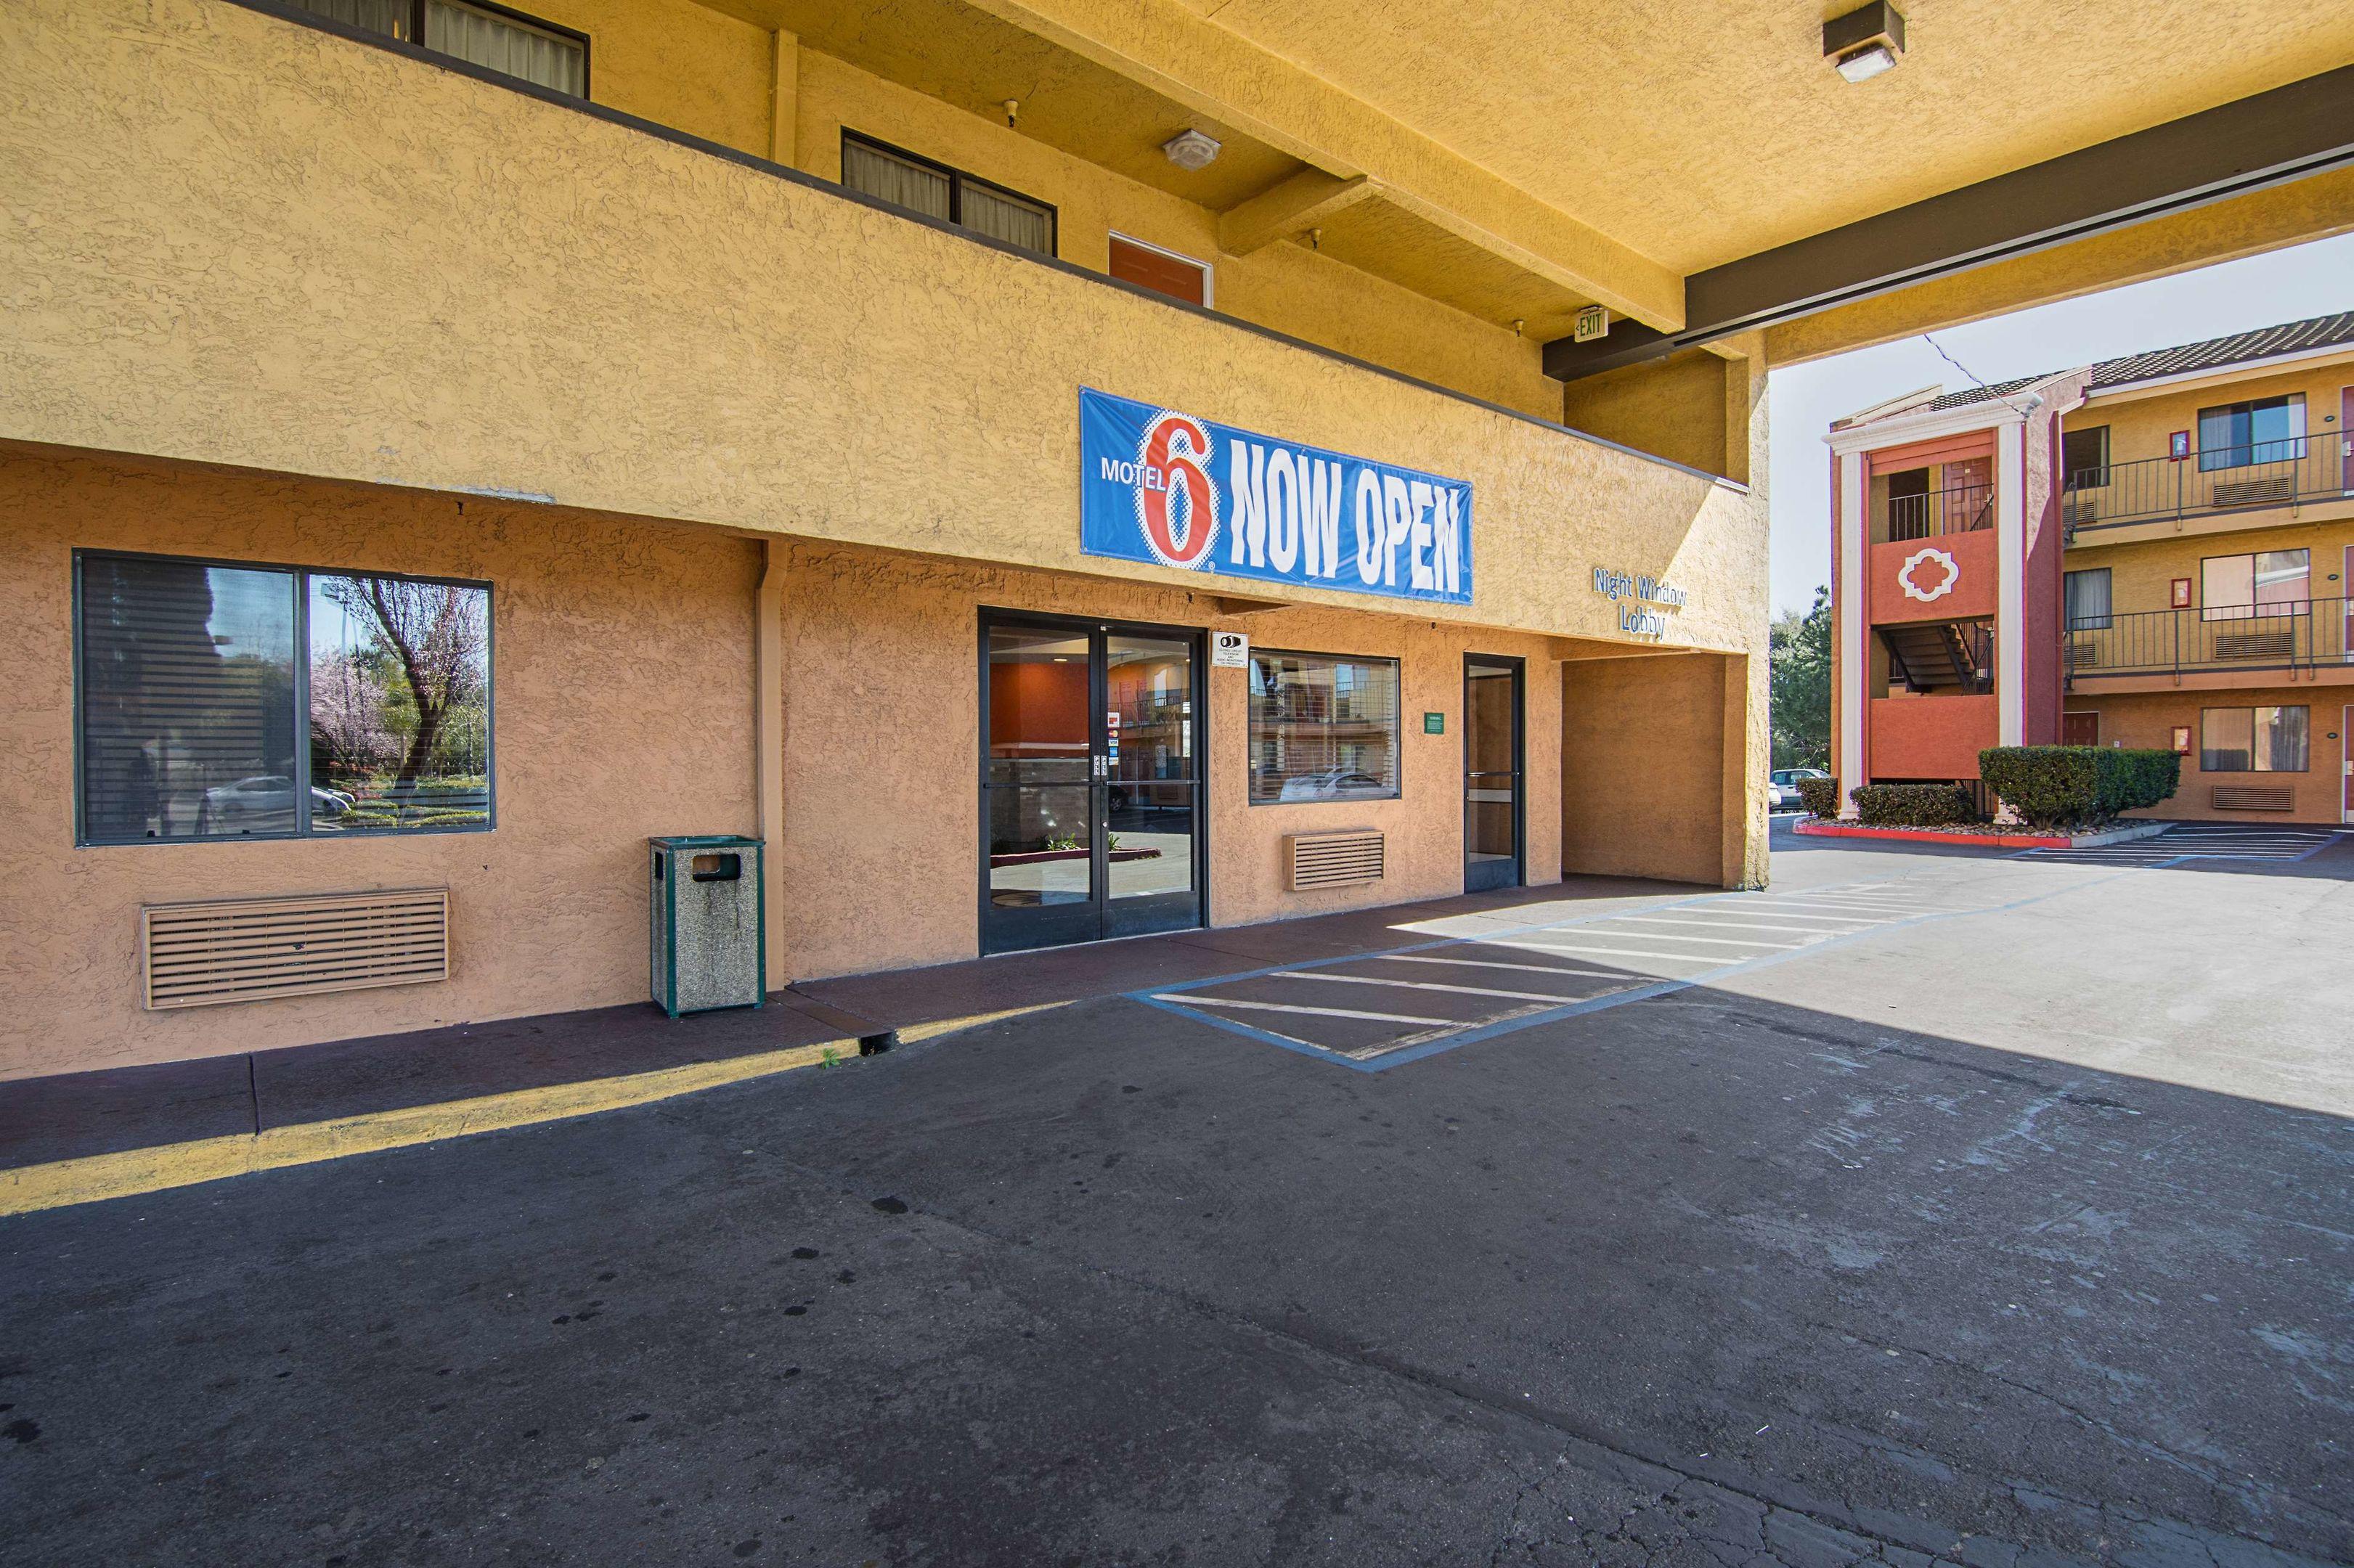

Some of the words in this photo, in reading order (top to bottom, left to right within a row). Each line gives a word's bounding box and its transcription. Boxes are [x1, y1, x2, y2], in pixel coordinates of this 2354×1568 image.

[1580, 314, 1601, 336] EXIT
[1101, 457, 1166, 492] MOTEL
[1139, 413, 1217, 565] 6
[1230, 438, 1342, 579] NOW
[1356, 468, 1460, 593] OPEN
[1593, 568, 1632, 600] Night
[1636, 575, 1687, 607] Window
[1618, 604, 1666, 641] Lobby
